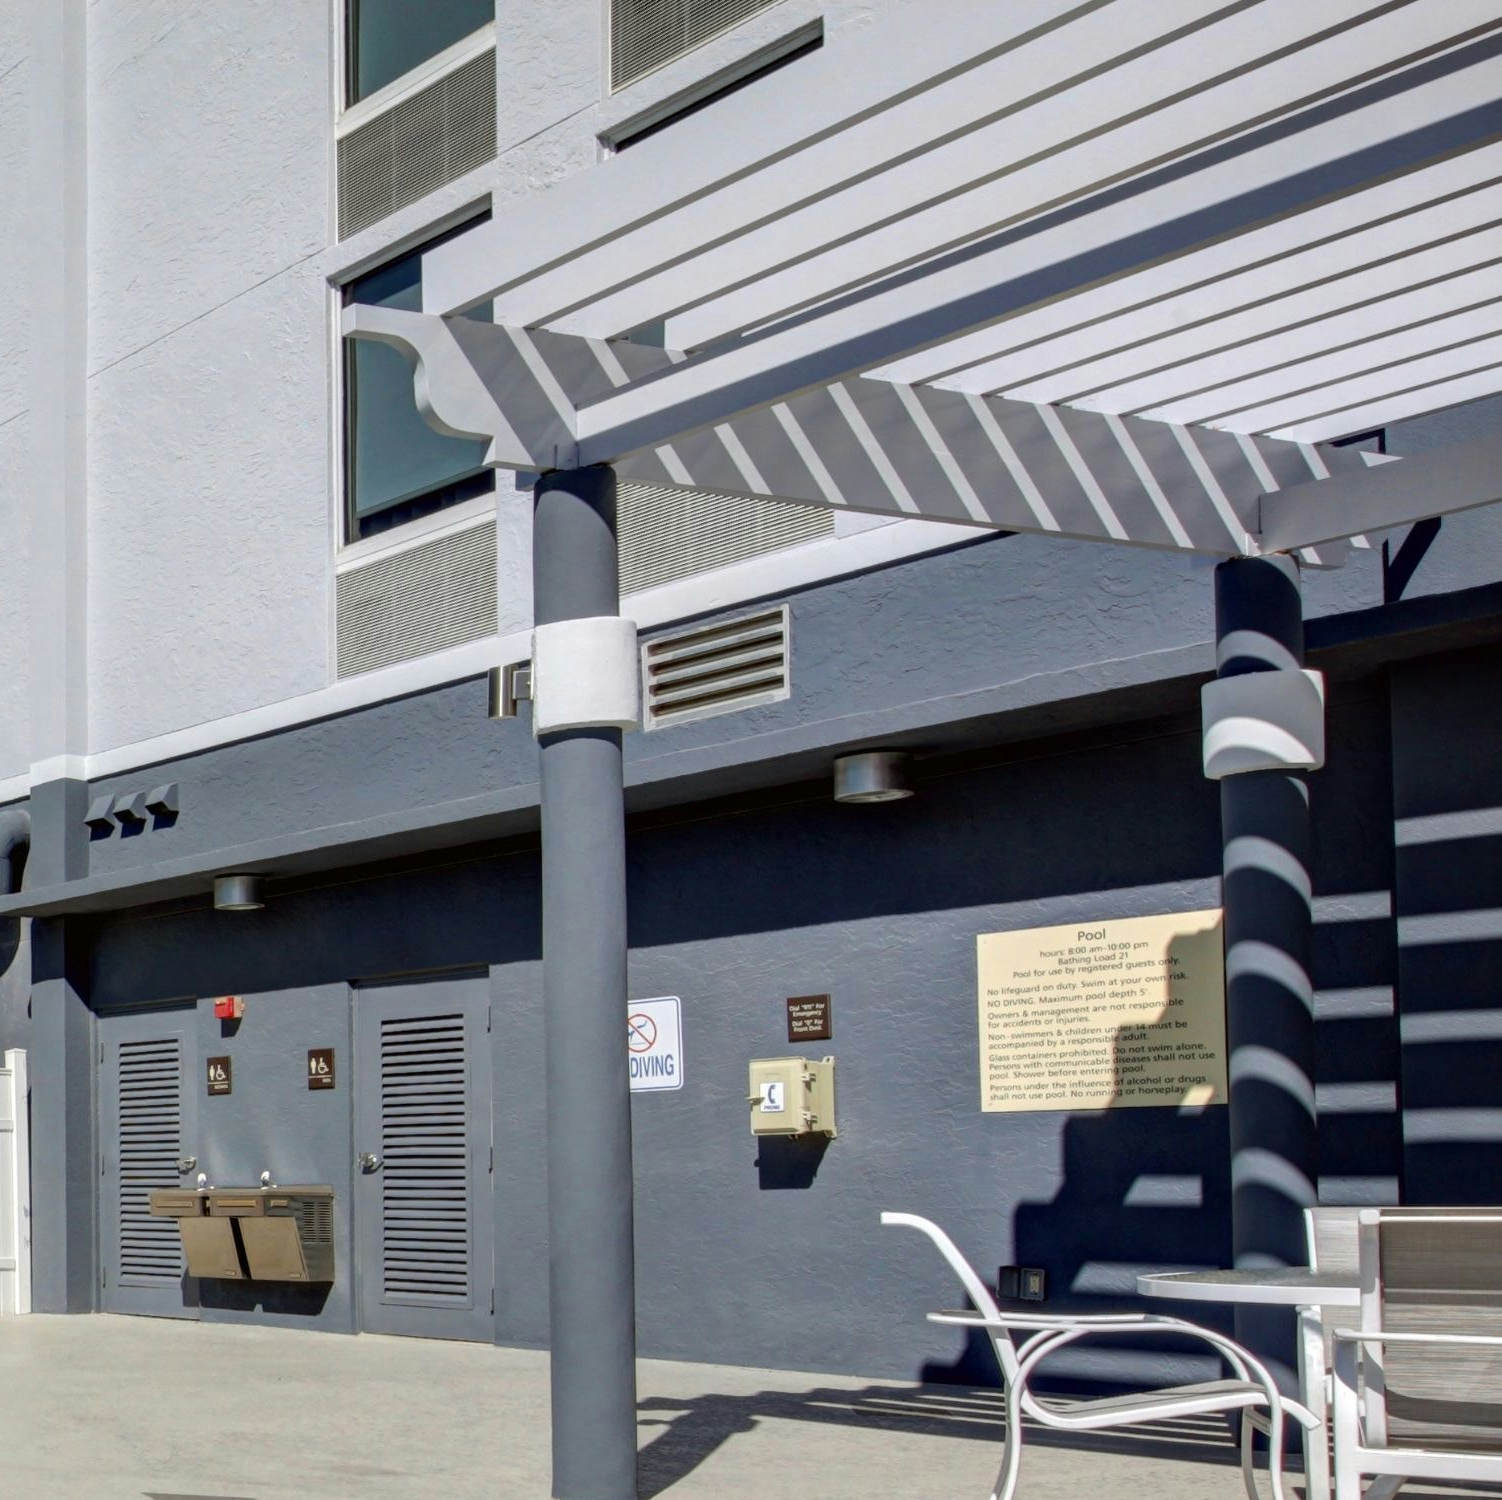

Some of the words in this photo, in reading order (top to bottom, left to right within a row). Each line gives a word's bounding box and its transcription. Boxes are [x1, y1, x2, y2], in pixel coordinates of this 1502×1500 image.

[1078, 928, 1105, 941] Pool
[1068, 947, 1086, 955] 8:00
[1058, 956, 1091, 965] Bathing
[1094, 953, 1116, 962] Load
[1013, 970, 1031, 978] Pool
[1065, 967, 1075, 975] by
[1078, 962, 1122, 973] registered
[1126, 960, 1155, 970] guests
[1001, 985, 1040, 995] lifeguard
[1081, 980, 1105, 988] Swim
[1121, 977, 1141, 986] your
[1039, 995, 1082, 1003] Maximum
[1086, 992, 1105, 1001] pool
[1109, 990, 1136, 1000] depth
[1031, 1006, 1089, 1017] management
[1110, 1003, 1126, 1011] not
[1129, 998, 1184, 1009] responsible
[1003, 1020, 1041, 1028] accidents
[1065, 1028, 1101, 1036] children
[1148, 1022, 1171, 1030] must
[989, 1040, 1044, 1050] accompanied
[1068, 1035, 1120, 1044] responsible
[989, 1054, 1010, 1062] Glass
[1012, 1052, 1056, 1060] containers
[1148, 1044, 1172, 1052] swim
[1045, 1057, 1110, 1067] communicable
[1113, 1055, 1150, 1064] diseases
[1153, 1053, 1175, 1061] shall
[1179, 1052, 1196, 1060] not
[1199, 1051, 1215, 1059] use
[631, 1054, 674, 1078] DIVING
[1048, 1069, 1077, 1077] before
[1080, 1065, 1118, 1075] entering
[1069, 1080, 1111, 1088] influence
[1127, 1077, 1161, 1085] alcohol
[1178, 1075, 1206, 1085] drugs
[1086, 1089, 1122, 1097] running
